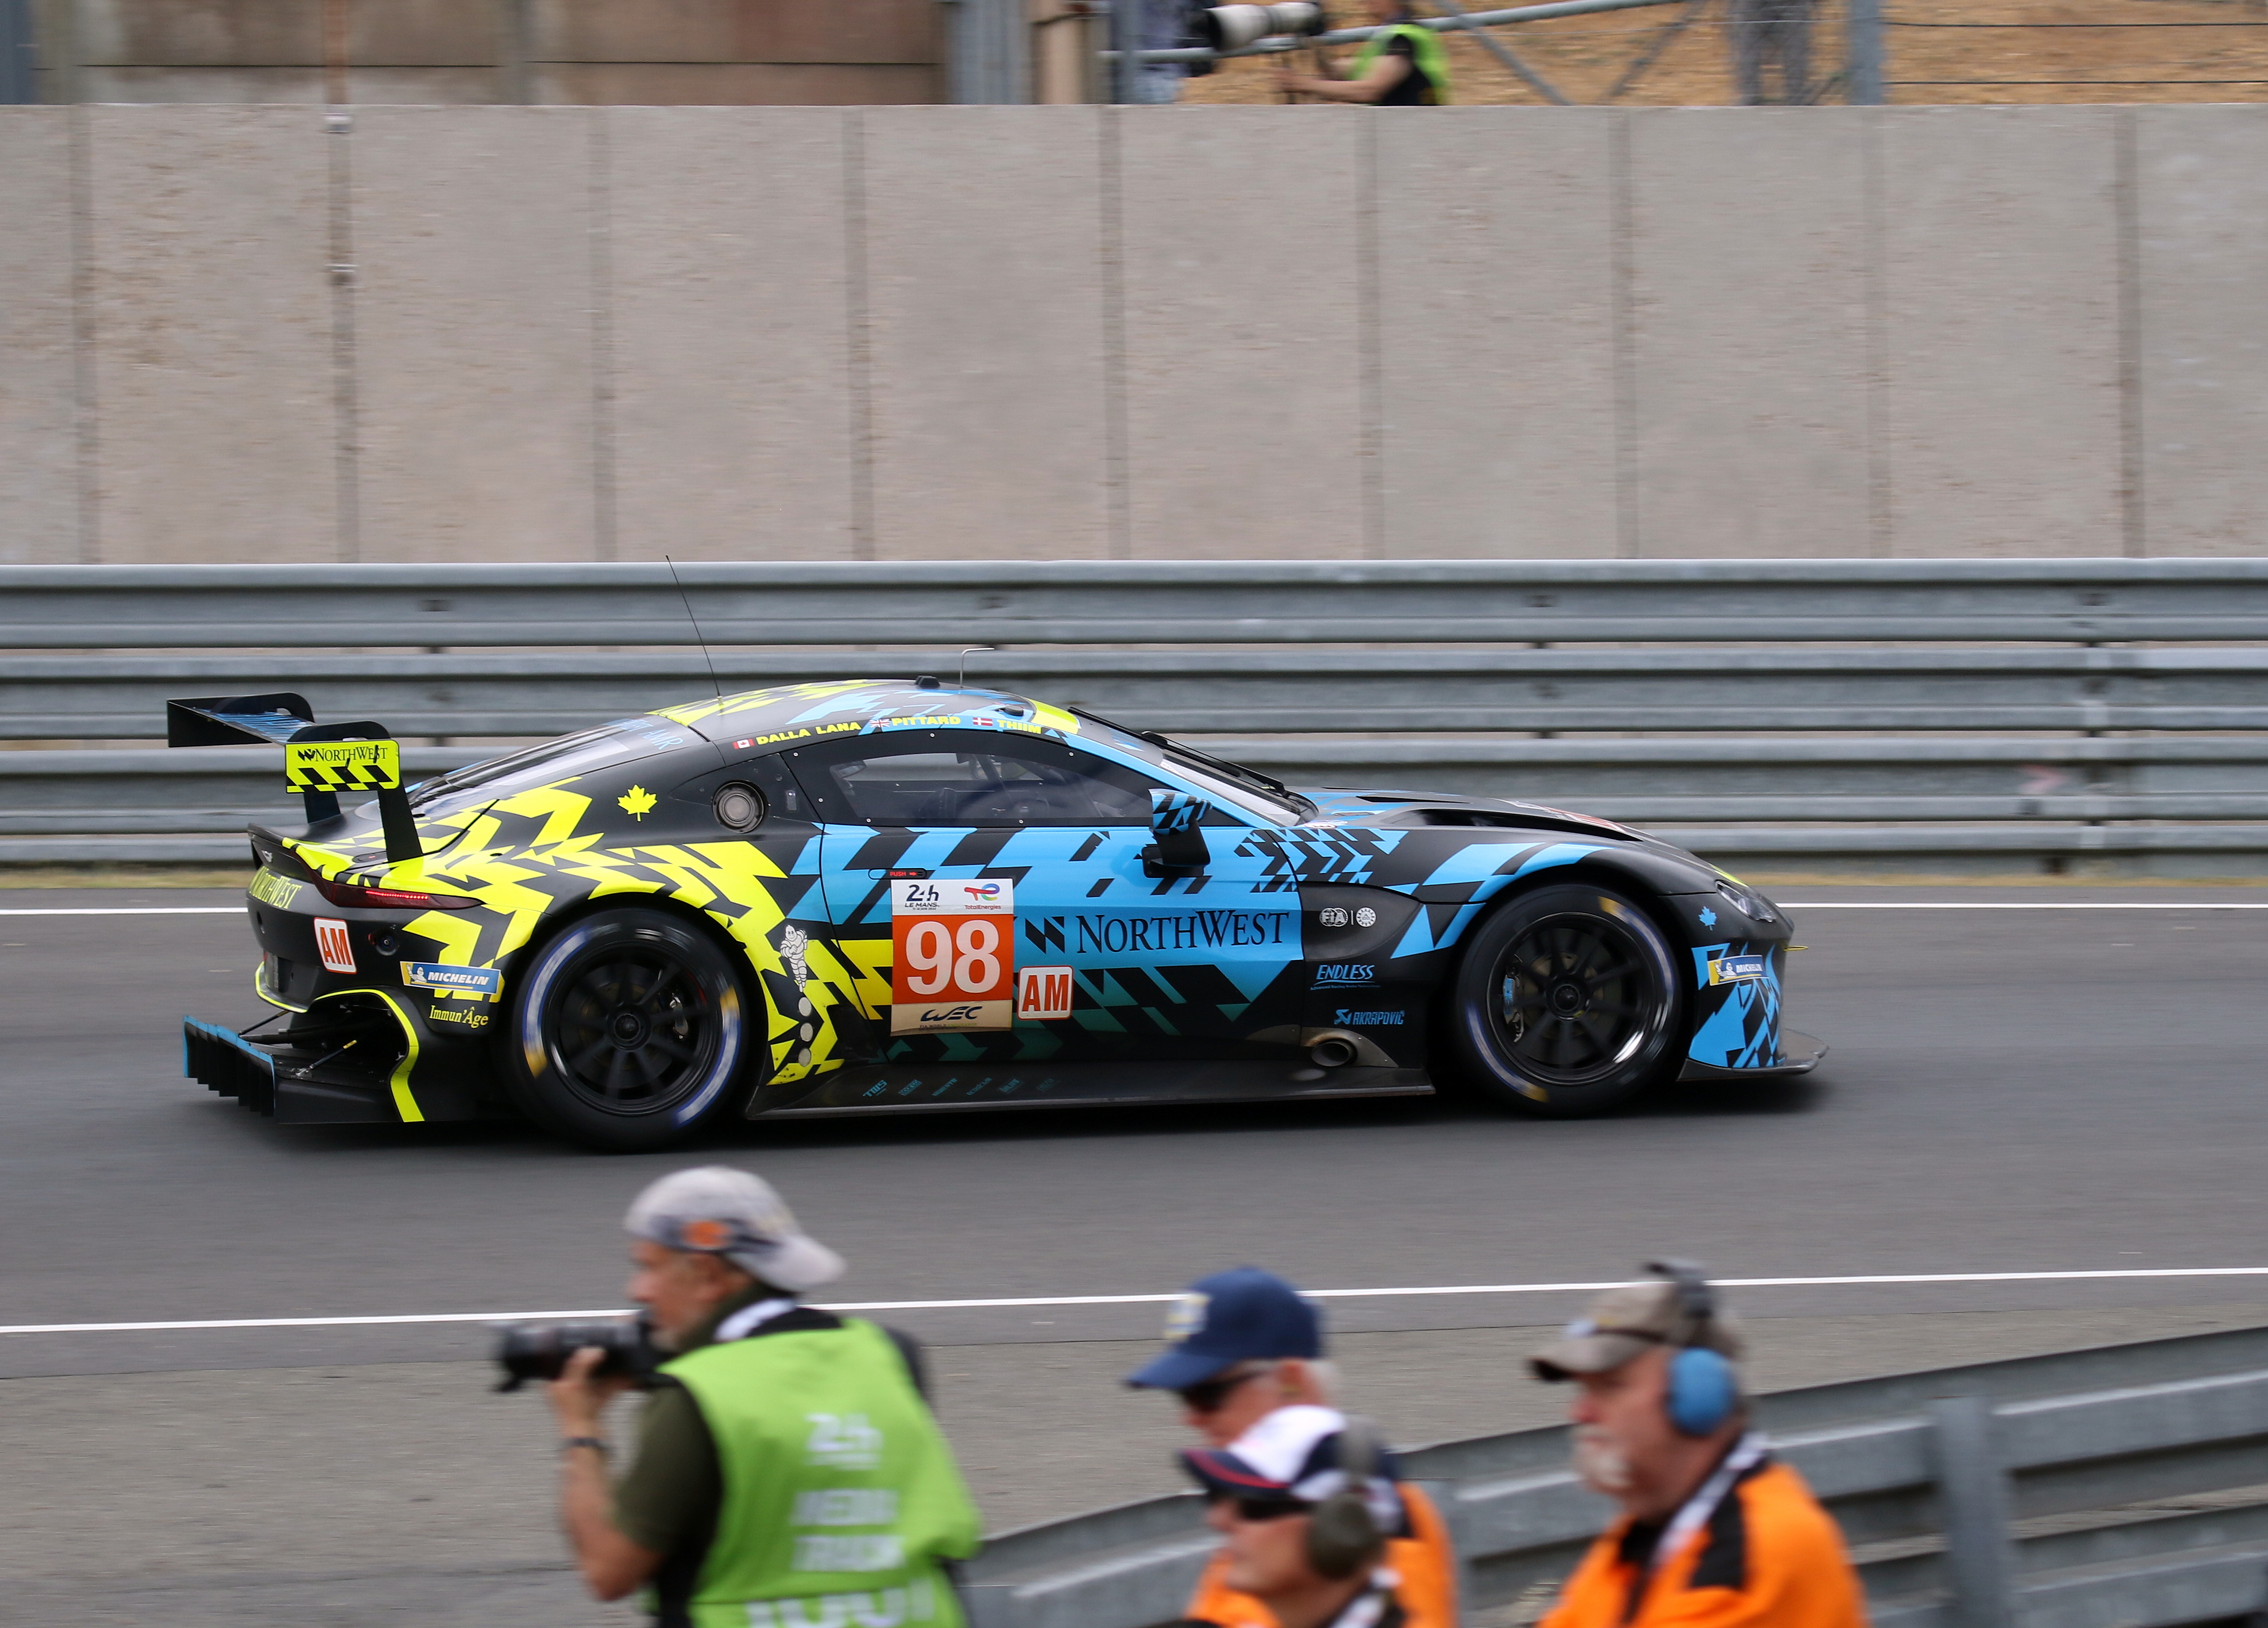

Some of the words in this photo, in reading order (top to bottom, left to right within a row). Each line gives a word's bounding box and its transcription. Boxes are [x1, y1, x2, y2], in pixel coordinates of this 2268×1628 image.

[891, 716, 961, 726] PITTARD
[996, 719, 1042, 734] THIIM
[755, 728, 812, 745] DALLA
[815, 722, 862, 735] LANA
[906, 884, 939, 902] 24h
[320, 926, 353, 966] AM
[905, 919, 1001, 995] 98
[427, 972, 489, 986] MICHELIN
[1316, 964, 1375, 980] ENDLESS
[1022, 974, 1069, 1012] AM
[920, 1005, 983, 1022] WEC
